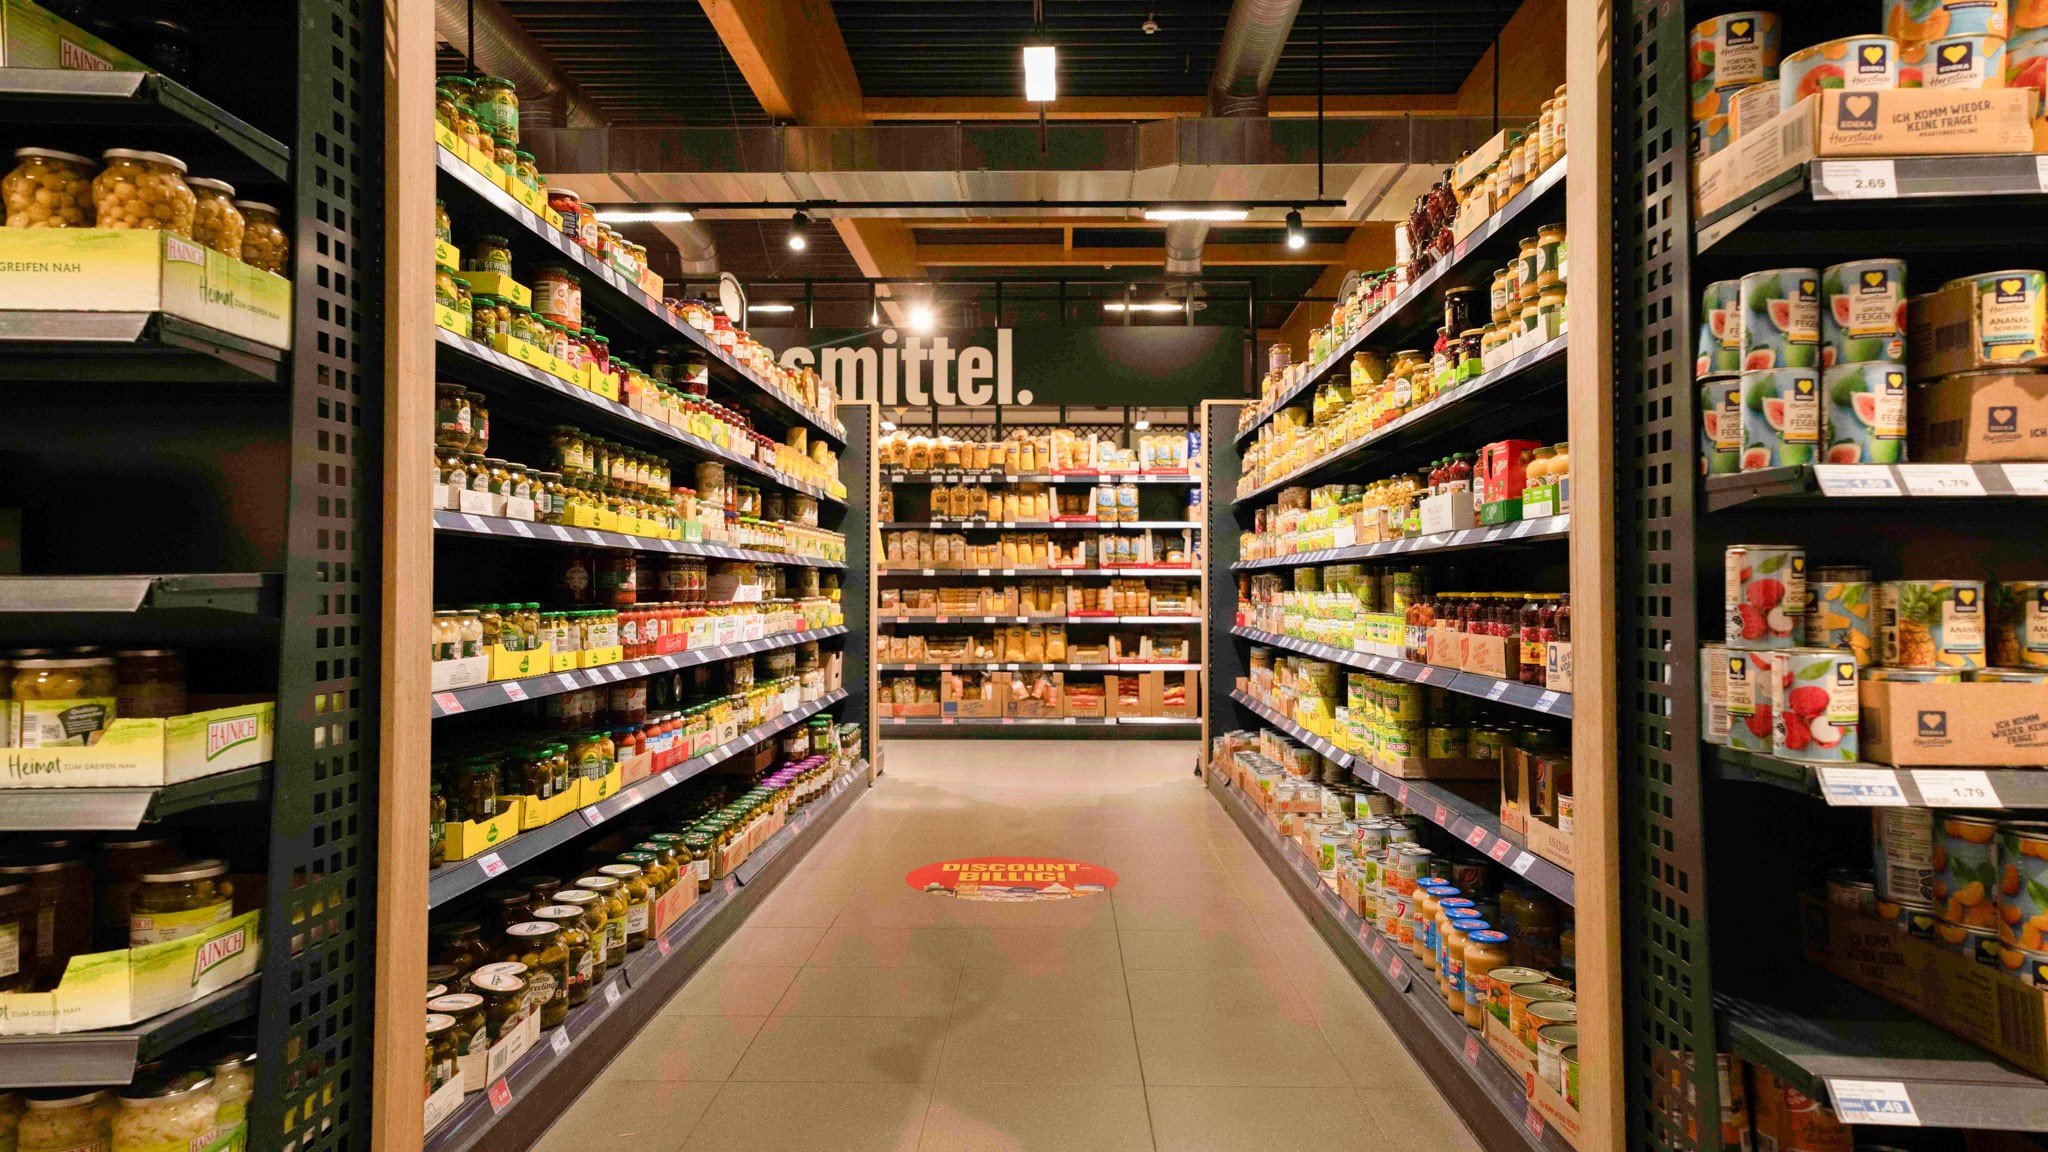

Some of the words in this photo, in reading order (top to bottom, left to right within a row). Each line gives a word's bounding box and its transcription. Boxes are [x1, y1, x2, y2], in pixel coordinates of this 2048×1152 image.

[1939, 63, 1970, 72] EDEKA
[1892, 113, 1910, 124] ICH
[1914, 107, 1947, 121] KOMM
[1951, 101, 1995, 114] WIEDER.
[1907, 119, 1938, 132] KEINE
[1942, 115, 1979, 129] FRAGE!
[1855, 179, 1886, 189] 2.69
[53, 262, 81, 272] NAH
[200, 274, 234, 308] Heimat
[1856, 312, 1892, 321] FEIGEN
[1990, 317, 2031, 326] ANANAS-
[766, 328, 1034, 406] smittel.
[2030, 428, 2048, 438] ICH
[1938, 479, 1969, 487] 1.79
[210, 717, 255, 752] HAINICH
[9, 754, 62, 779] Heimat
[64, 763, 82, 771] ZUM
[84, 762, 116, 770] GREIFEN
[1858, 786, 1892, 796] 1.99
[1952, 788, 1985, 797] 1.79
[942, 863, 1092, 872] DISCOUNT-
[958, 872, 1067, 882] BILLIG!
[198, 931, 243, 968] AINICH
[1870, 1100, 1904, 1113] 1.49
